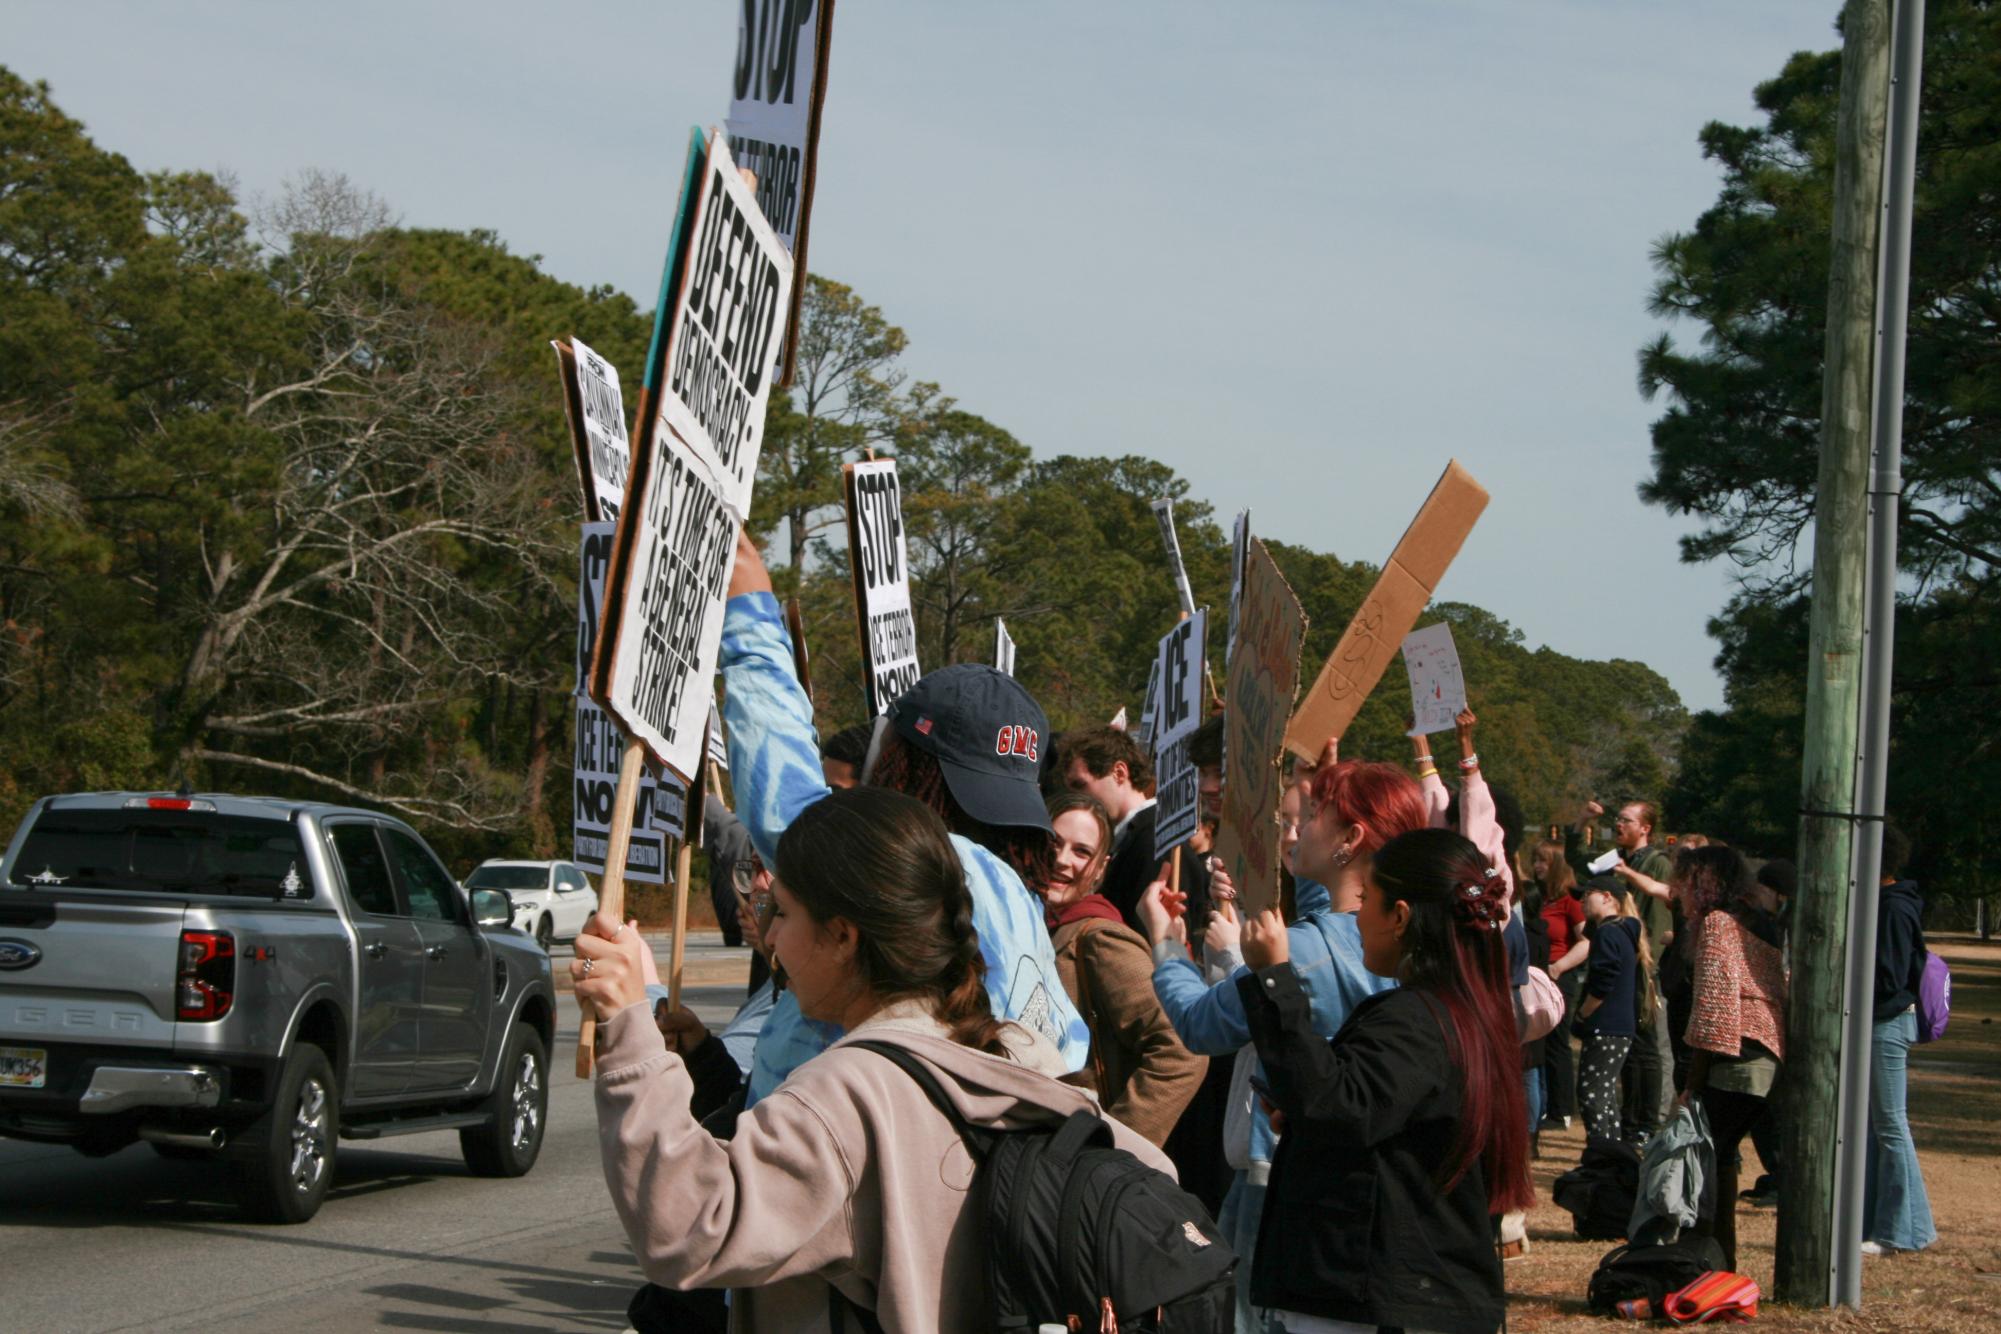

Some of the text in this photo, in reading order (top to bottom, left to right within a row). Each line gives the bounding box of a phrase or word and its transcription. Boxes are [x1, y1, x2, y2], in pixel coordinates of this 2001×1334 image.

[689, 168, 780, 397] DEFEND
[649, 438, 734, 602] IT'S TIME FOR
[857, 472, 901, 589] STOP
[639, 533, 710, 674] A GENERAL
[869, 614, 886, 666] ICE
[632, 625, 689, 745] STRIKE!
[1164, 621, 1192, 734] ICE
[577, 708, 598, 772] ICE
[996, 725, 1037, 762] GMC
